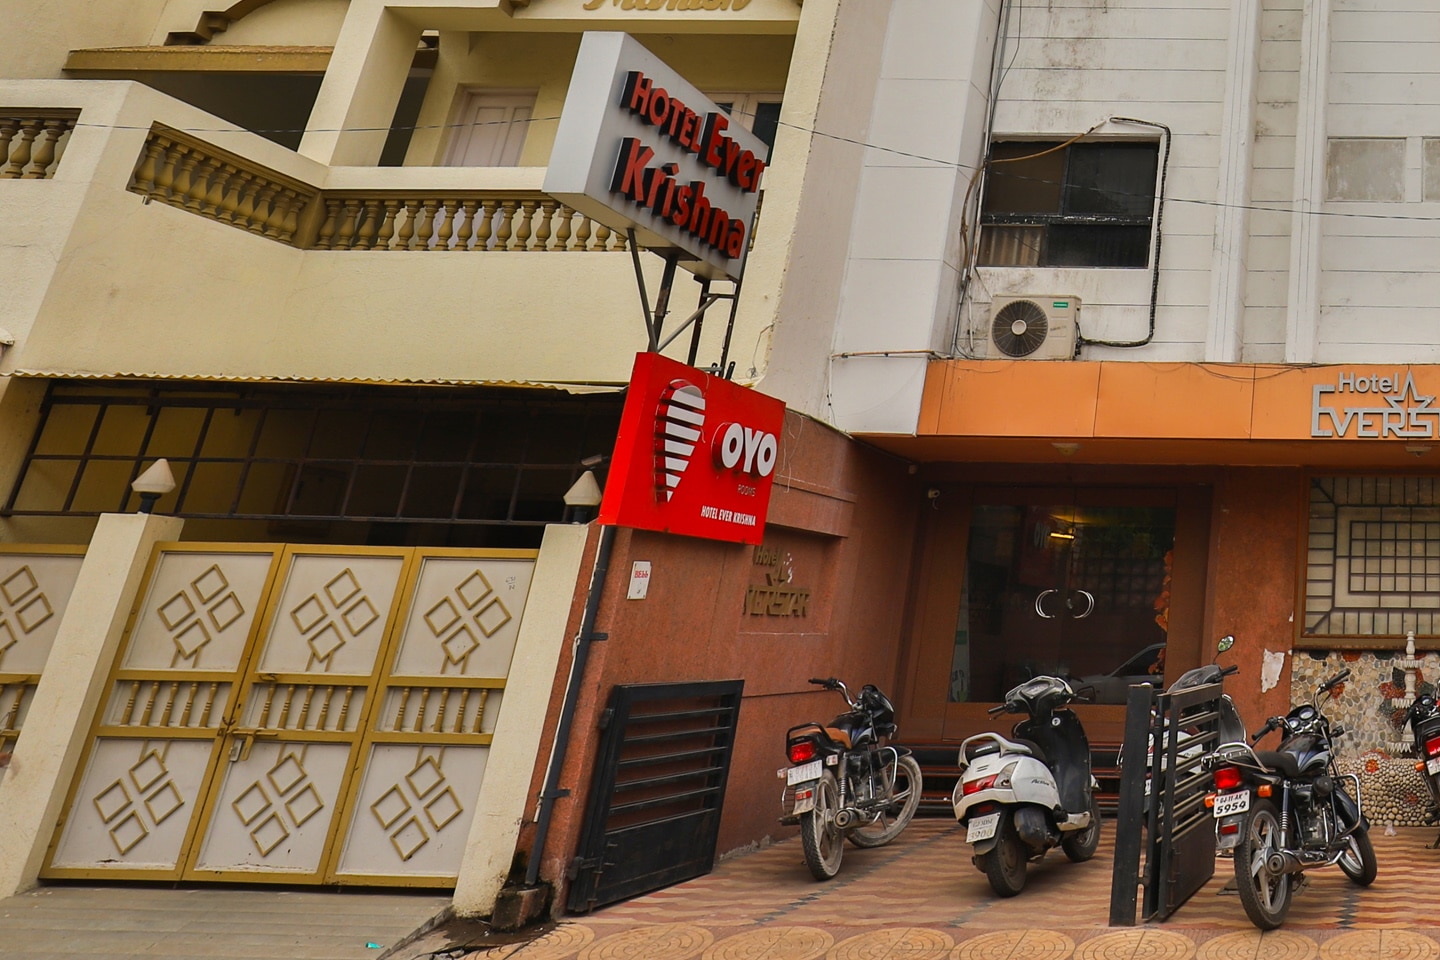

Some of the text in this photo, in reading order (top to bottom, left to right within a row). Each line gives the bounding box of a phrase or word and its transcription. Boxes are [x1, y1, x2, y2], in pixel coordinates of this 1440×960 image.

[621, 71, 767, 193] HOTEL Ever
[609, 137, 745, 259] Krishna
[1337, 372, 1399, 392] Hotel
[719, 422, 778, 477] OYO
[700, 505, 757, 527] HOTEL EVER KRISHNA
